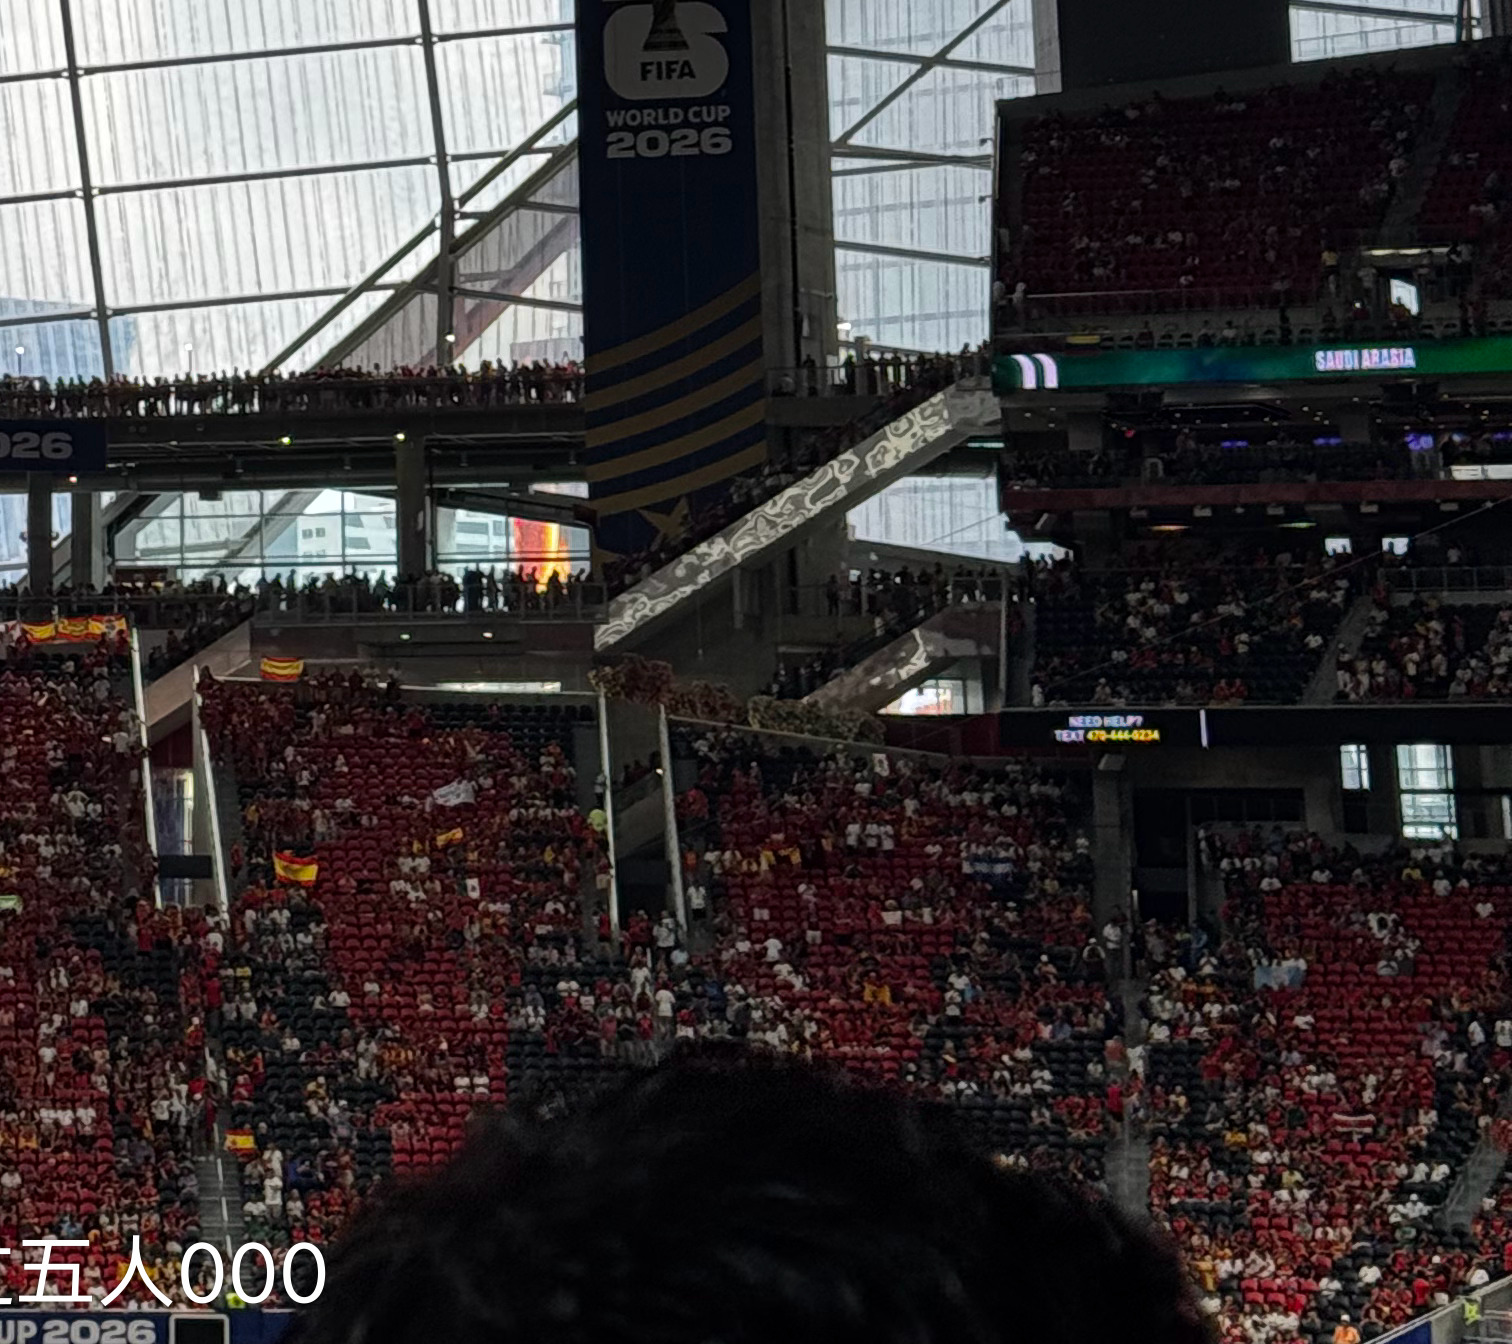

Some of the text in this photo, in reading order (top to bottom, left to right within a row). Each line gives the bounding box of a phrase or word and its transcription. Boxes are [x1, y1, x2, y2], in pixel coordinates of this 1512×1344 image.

[639, 60, 696, 82] FIFA
[605, 105, 731, 127] WORLD CUP
[606, 126, 733, 159] 2026
[1315, 347, 1416, 371] SAUDI ARABIA
[1069, 715, 1102, 727] NEED
[1054, 730, 1085, 743] TEXT
[42, 1319, 157, 1344] 2026
